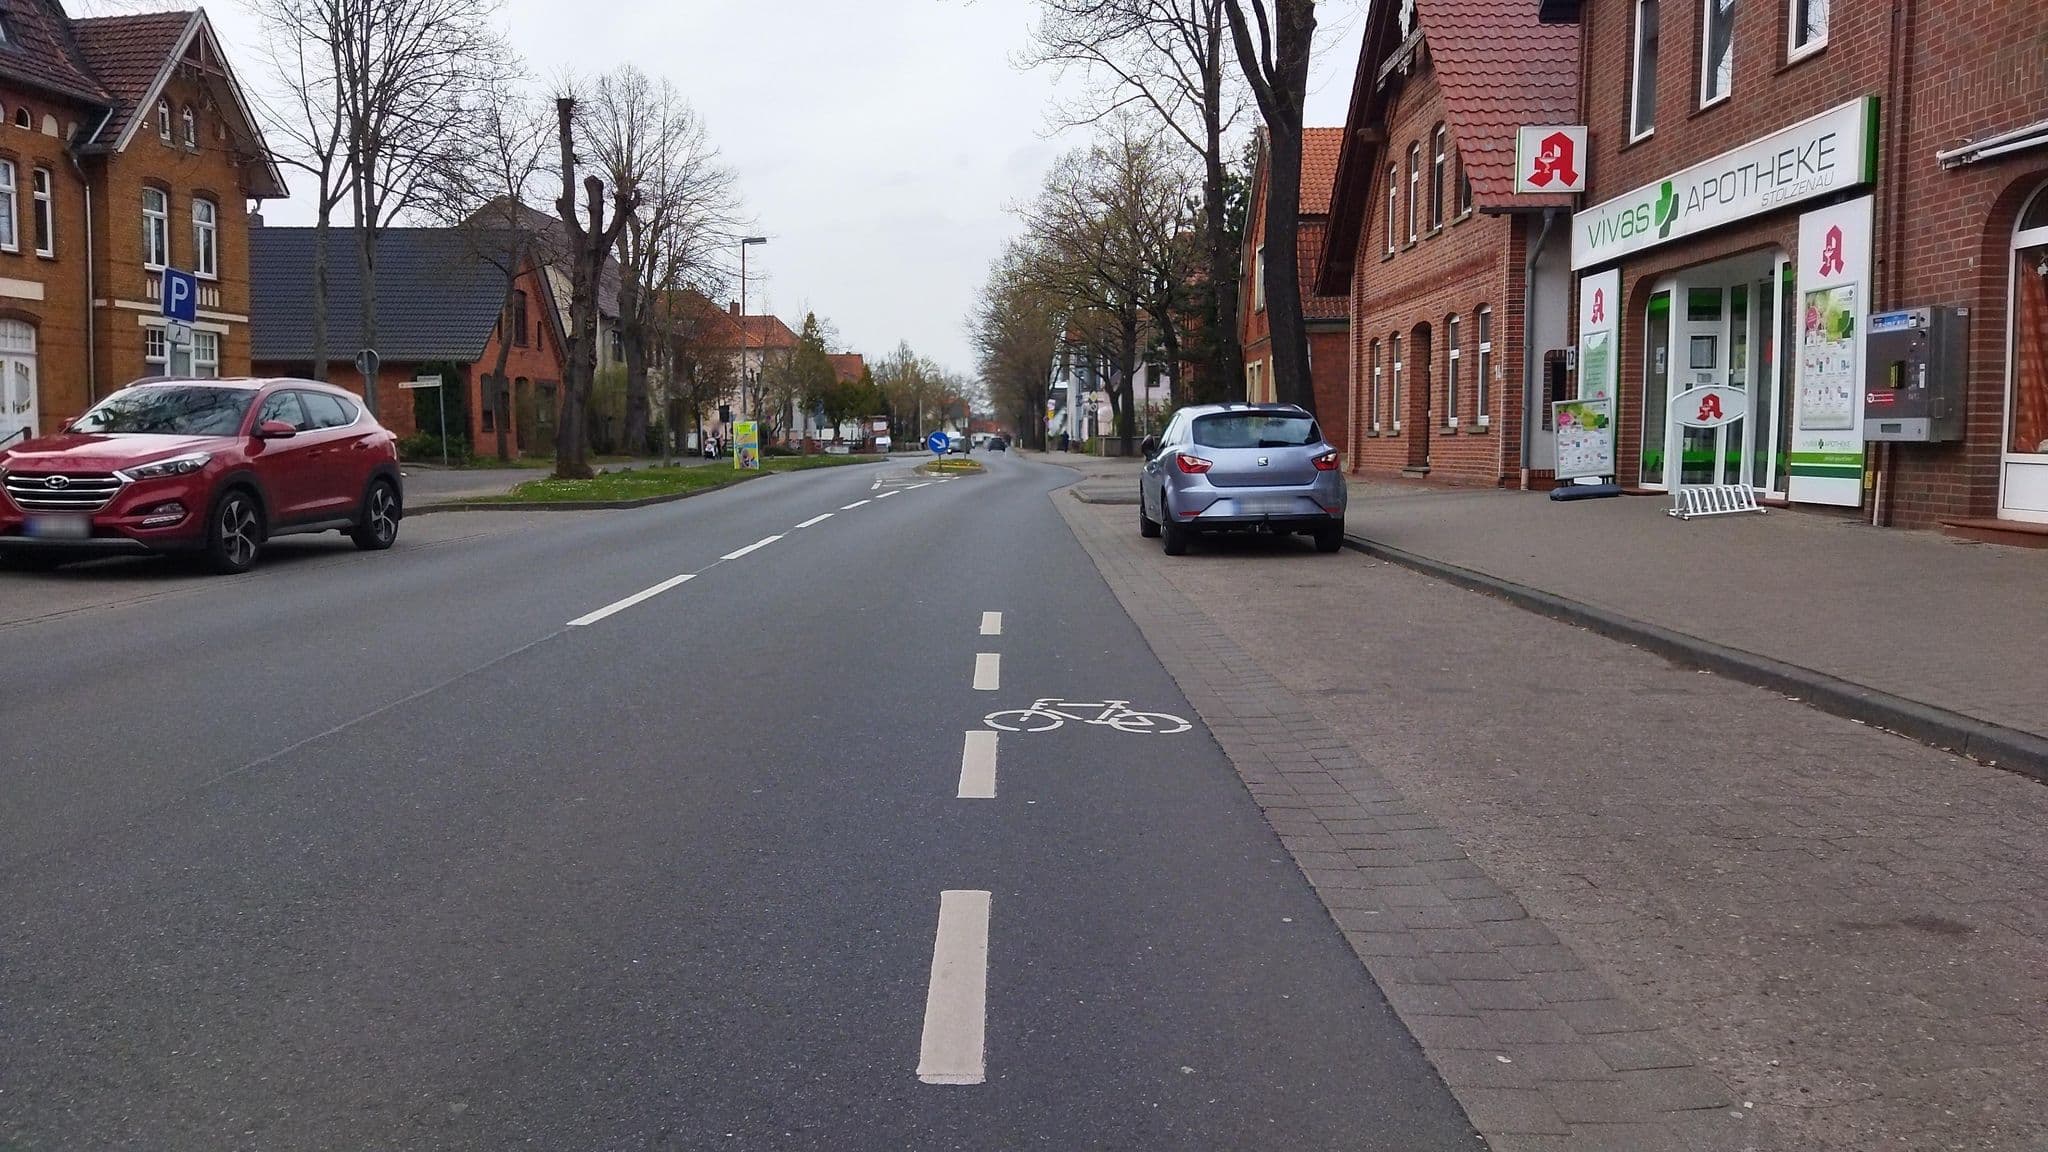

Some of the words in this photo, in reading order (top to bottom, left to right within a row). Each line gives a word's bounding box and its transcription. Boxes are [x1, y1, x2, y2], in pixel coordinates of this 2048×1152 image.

[1685, 132, 1836, 217] APOTHEKE
[1761, 171, 1834, 207] STOLZENAU
[171, 276, 188, 313] P
[1567, 350, 1575, 366] 12
